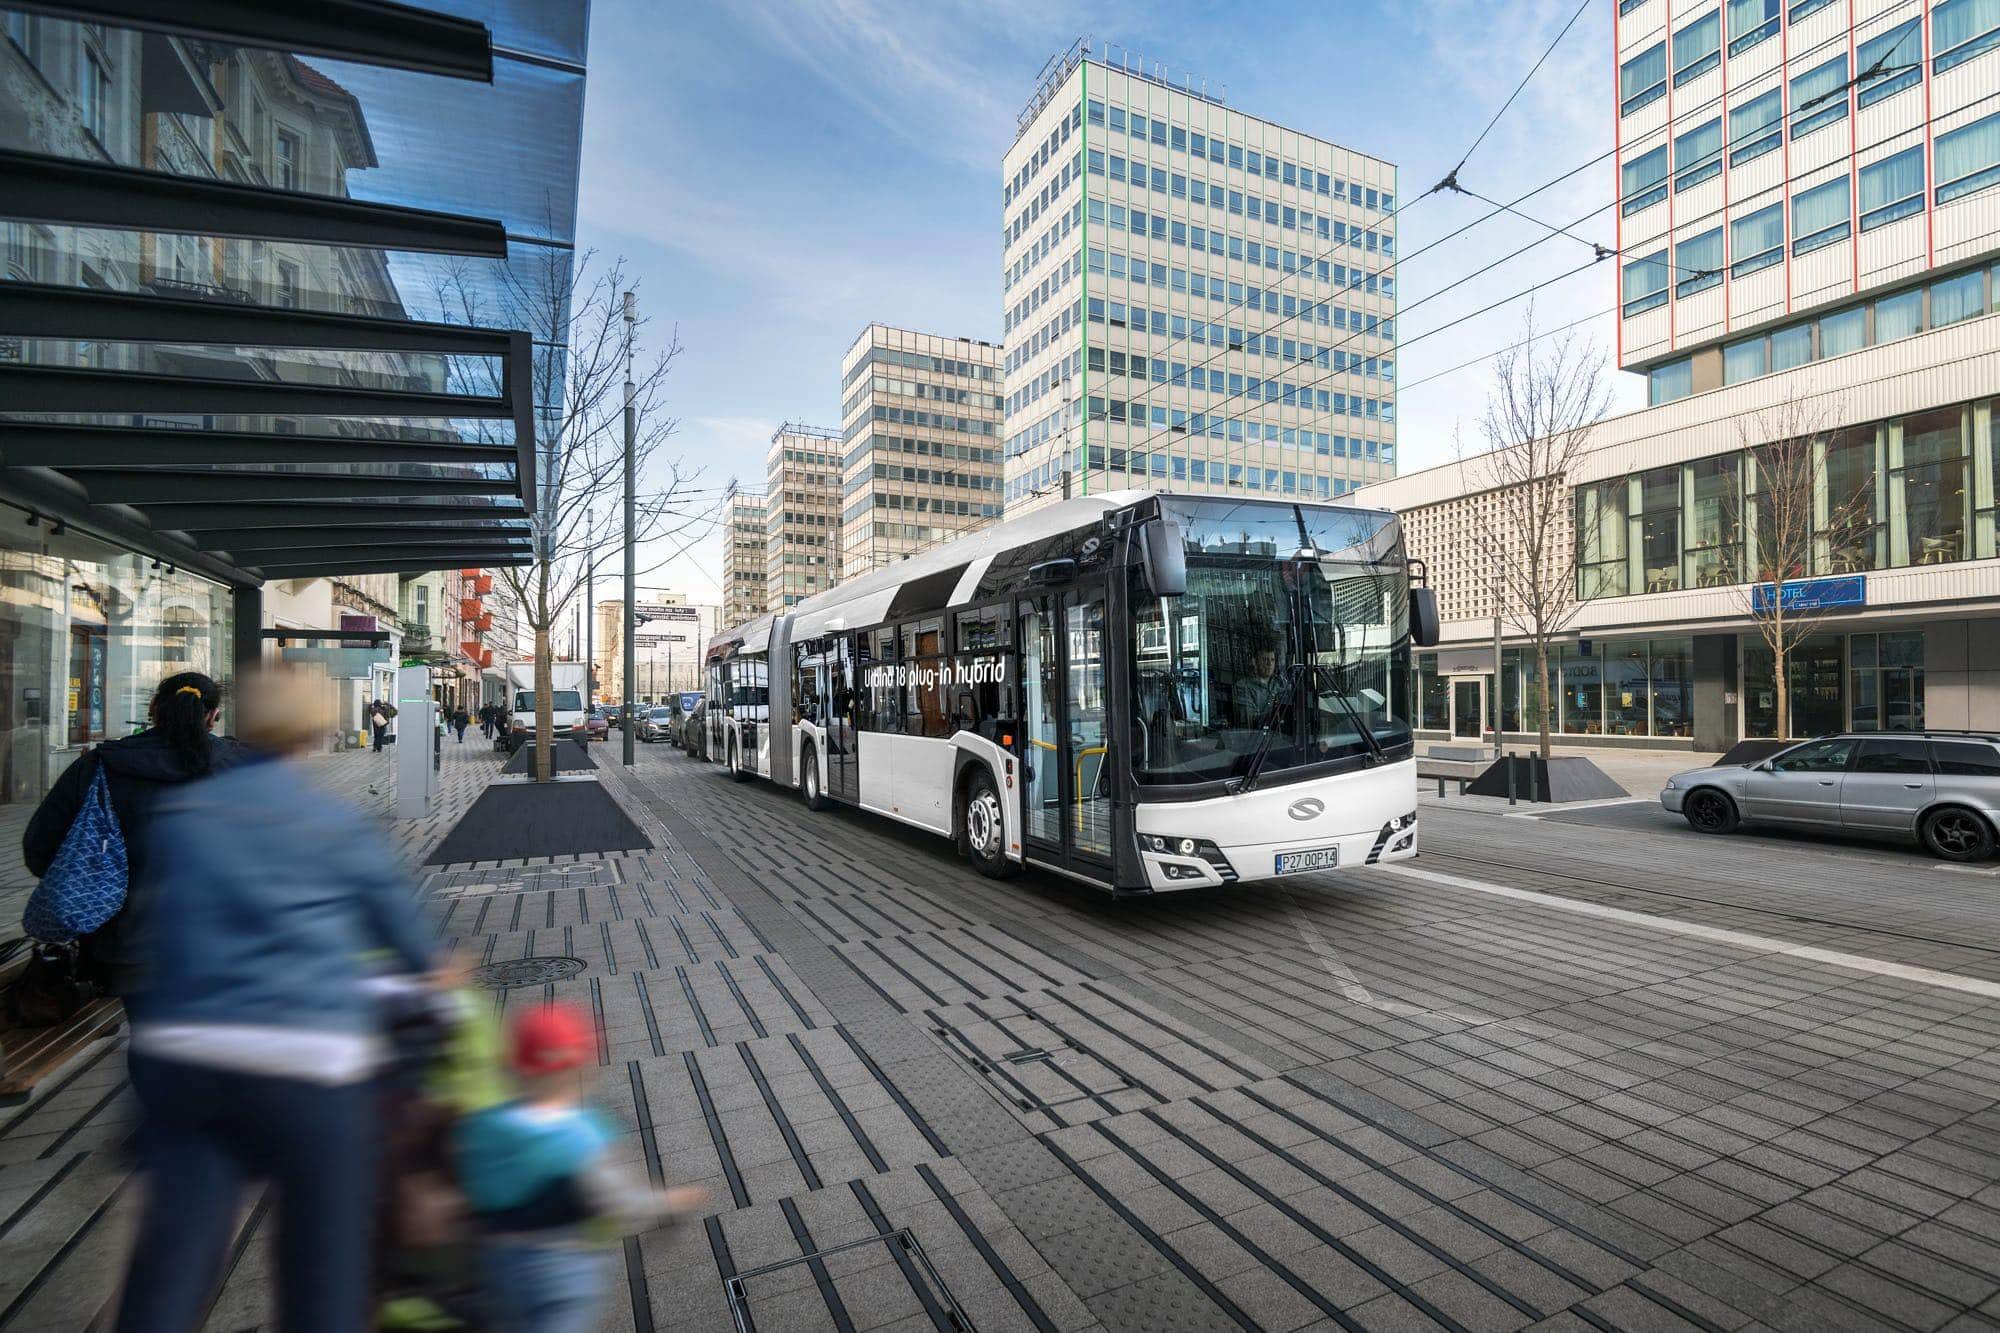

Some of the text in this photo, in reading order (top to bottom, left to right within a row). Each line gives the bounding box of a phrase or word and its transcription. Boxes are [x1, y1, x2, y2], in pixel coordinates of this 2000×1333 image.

[1766, 588, 1806, 600] HOTEL
[864, 655, 1005, 691] Urbino 18 plug-in hybrid
